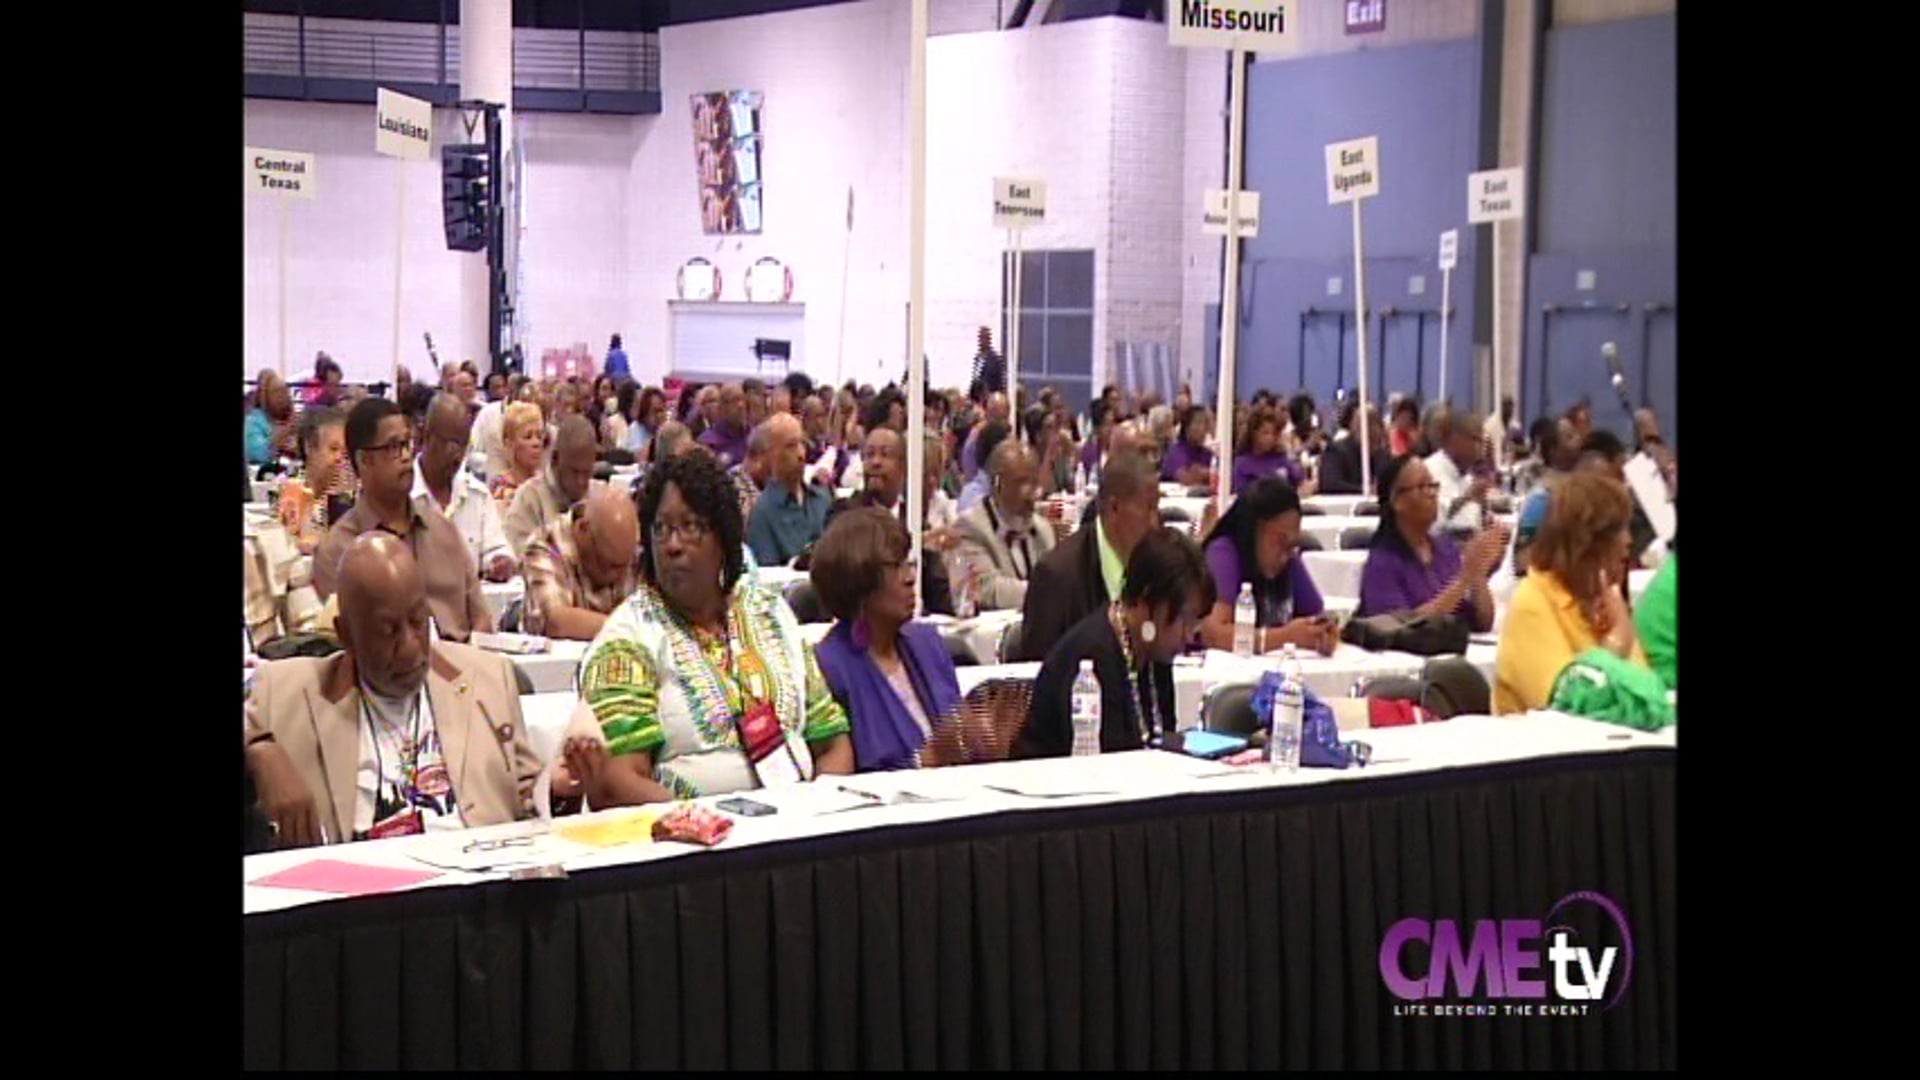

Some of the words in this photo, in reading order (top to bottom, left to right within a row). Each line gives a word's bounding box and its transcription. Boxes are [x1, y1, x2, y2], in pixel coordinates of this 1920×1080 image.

[1180, 0, 1285, 33] Missouri
[379, 113, 428, 141] Louisiana
[255, 157, 305, 173] Central
[1341, 150, 1363, 166] East
[260, 175, 300, 190] Texas
[1333, 174, 1371, 192] Uganda
[1484, 180, 1508, 194] East
[1008, 183, 1031, 199] East
[1480, 199, 1511, 212] Texas
